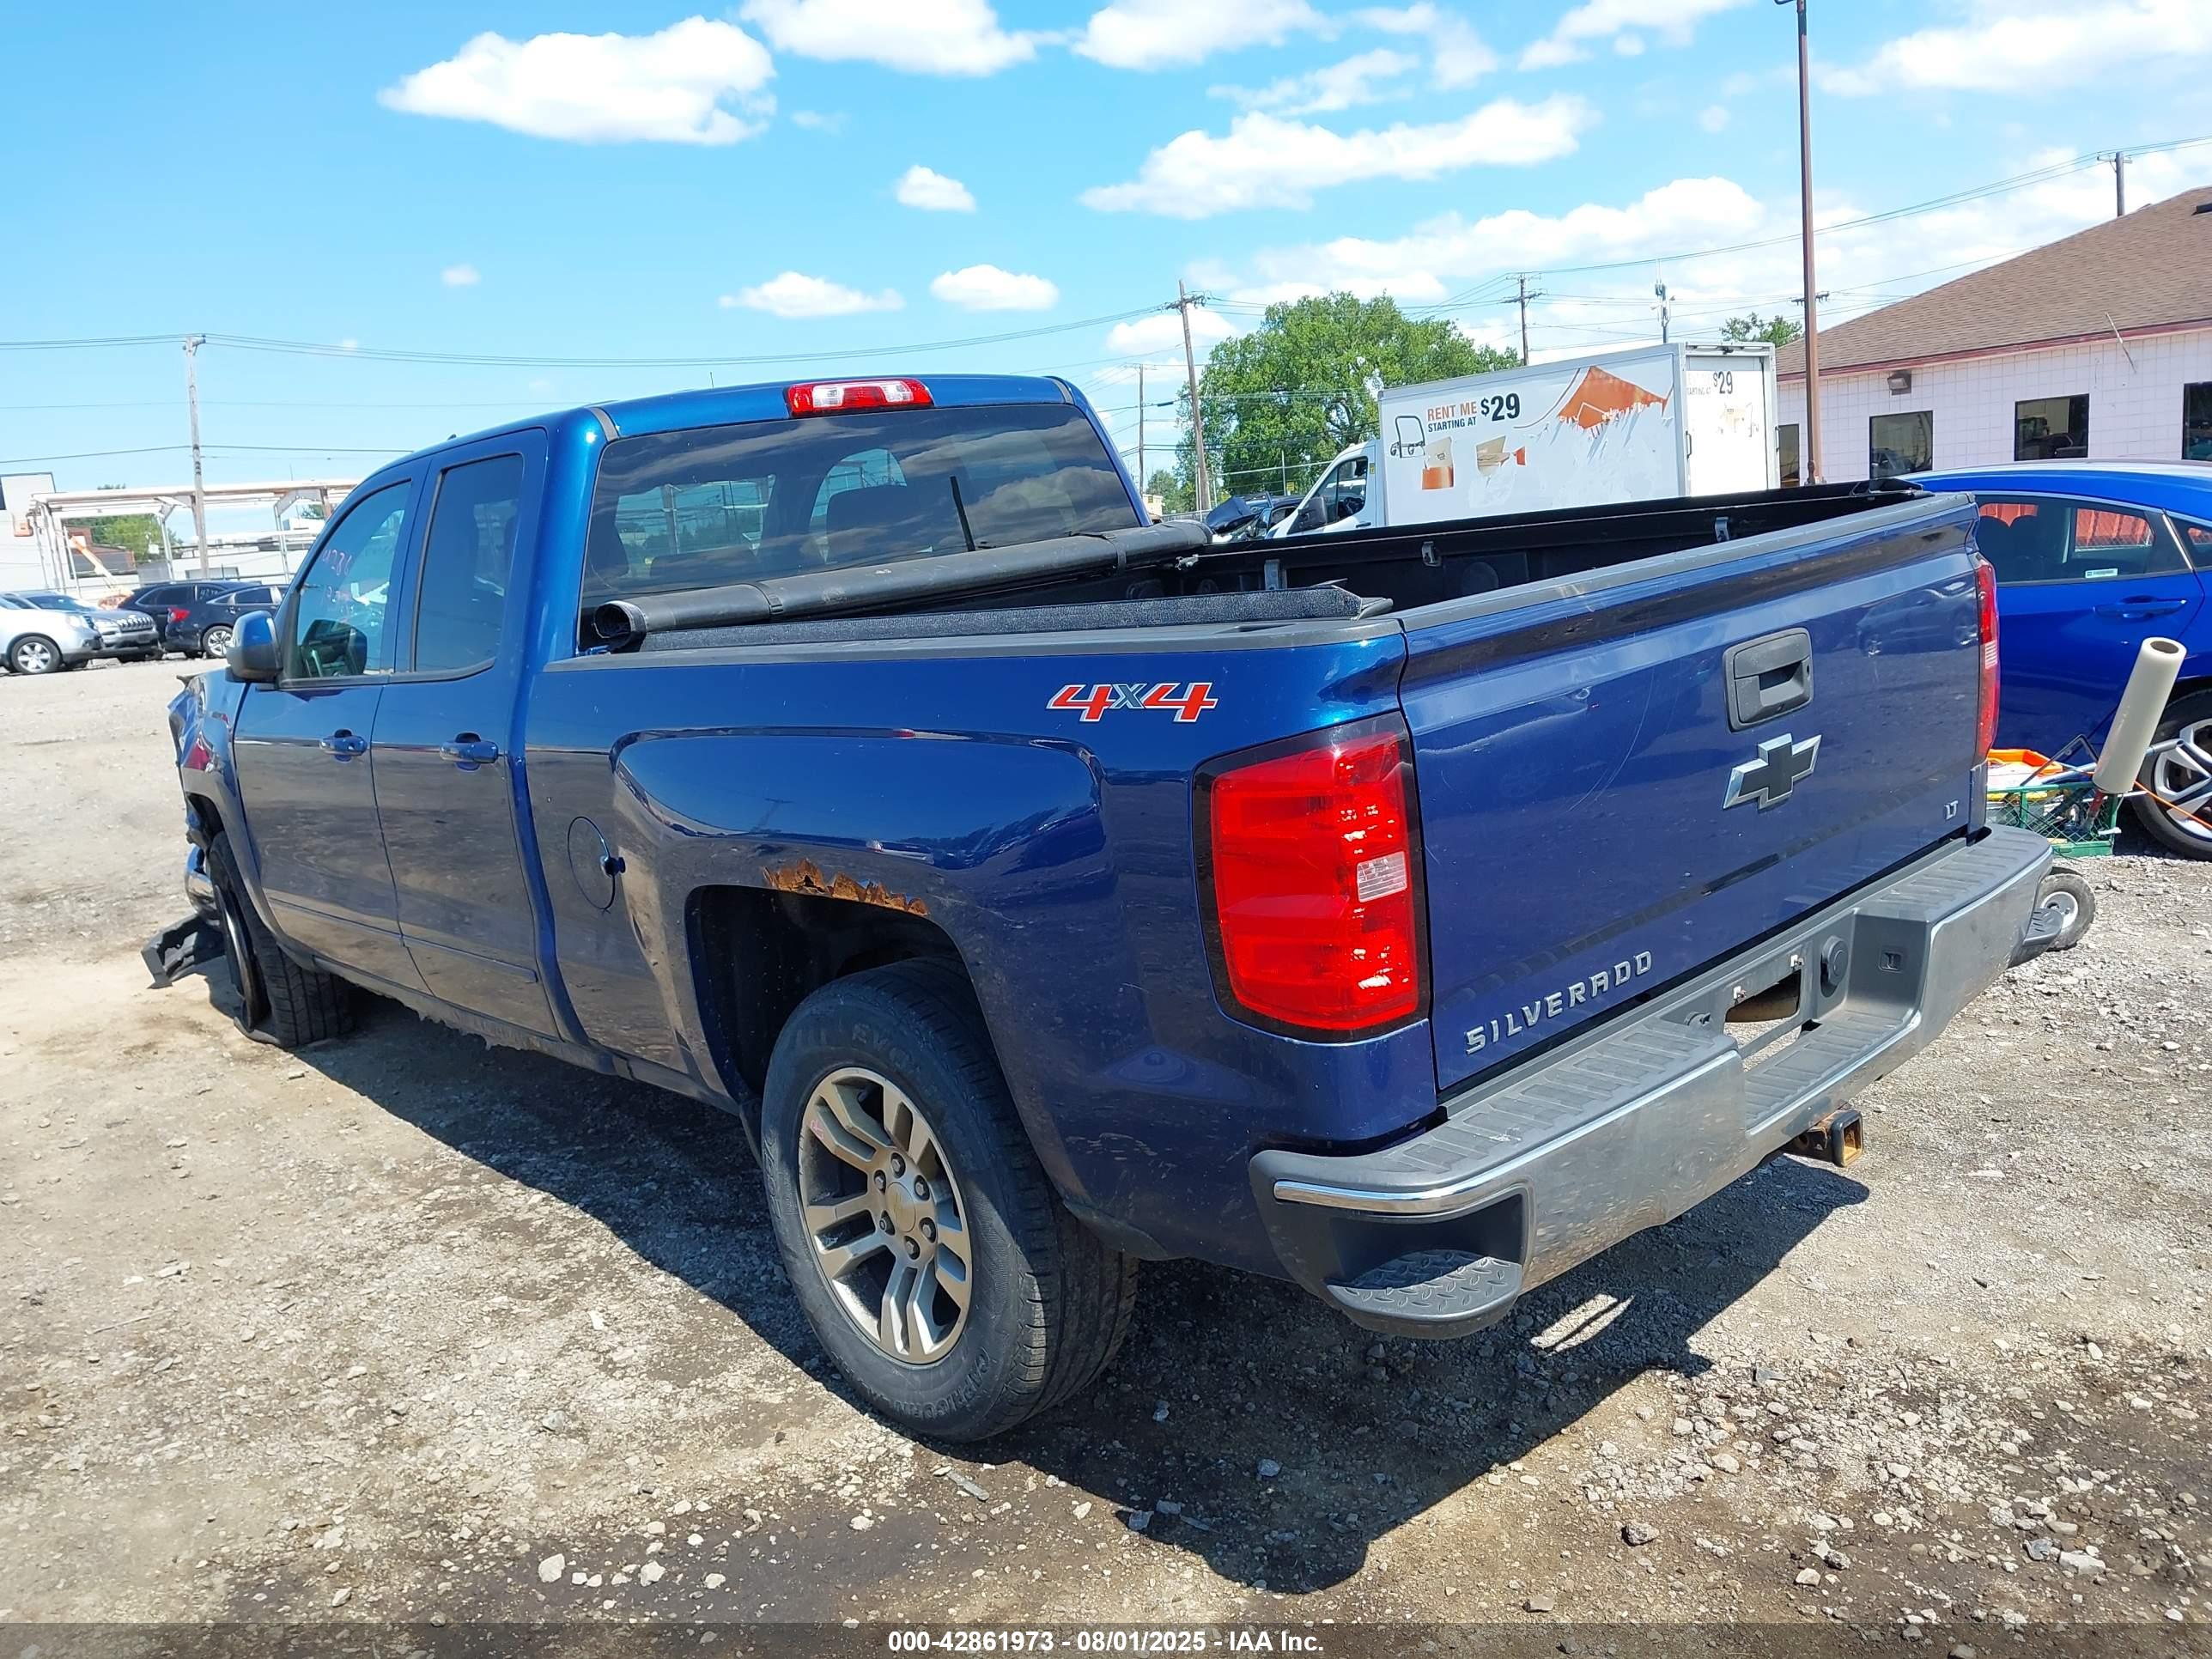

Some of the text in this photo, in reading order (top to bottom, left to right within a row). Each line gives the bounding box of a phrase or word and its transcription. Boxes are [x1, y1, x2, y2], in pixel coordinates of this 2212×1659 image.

[1713, 371, 1733, 394] $29
[1427, 401, 1477, 422] RENT ME
[1480, 392, 1520, 422] $29
[1428, 416, 1477, 432] STARTING AT
[1944, 800, 1958, 820] LT
[1466, 951, 1652, 1054] SILVERADO
